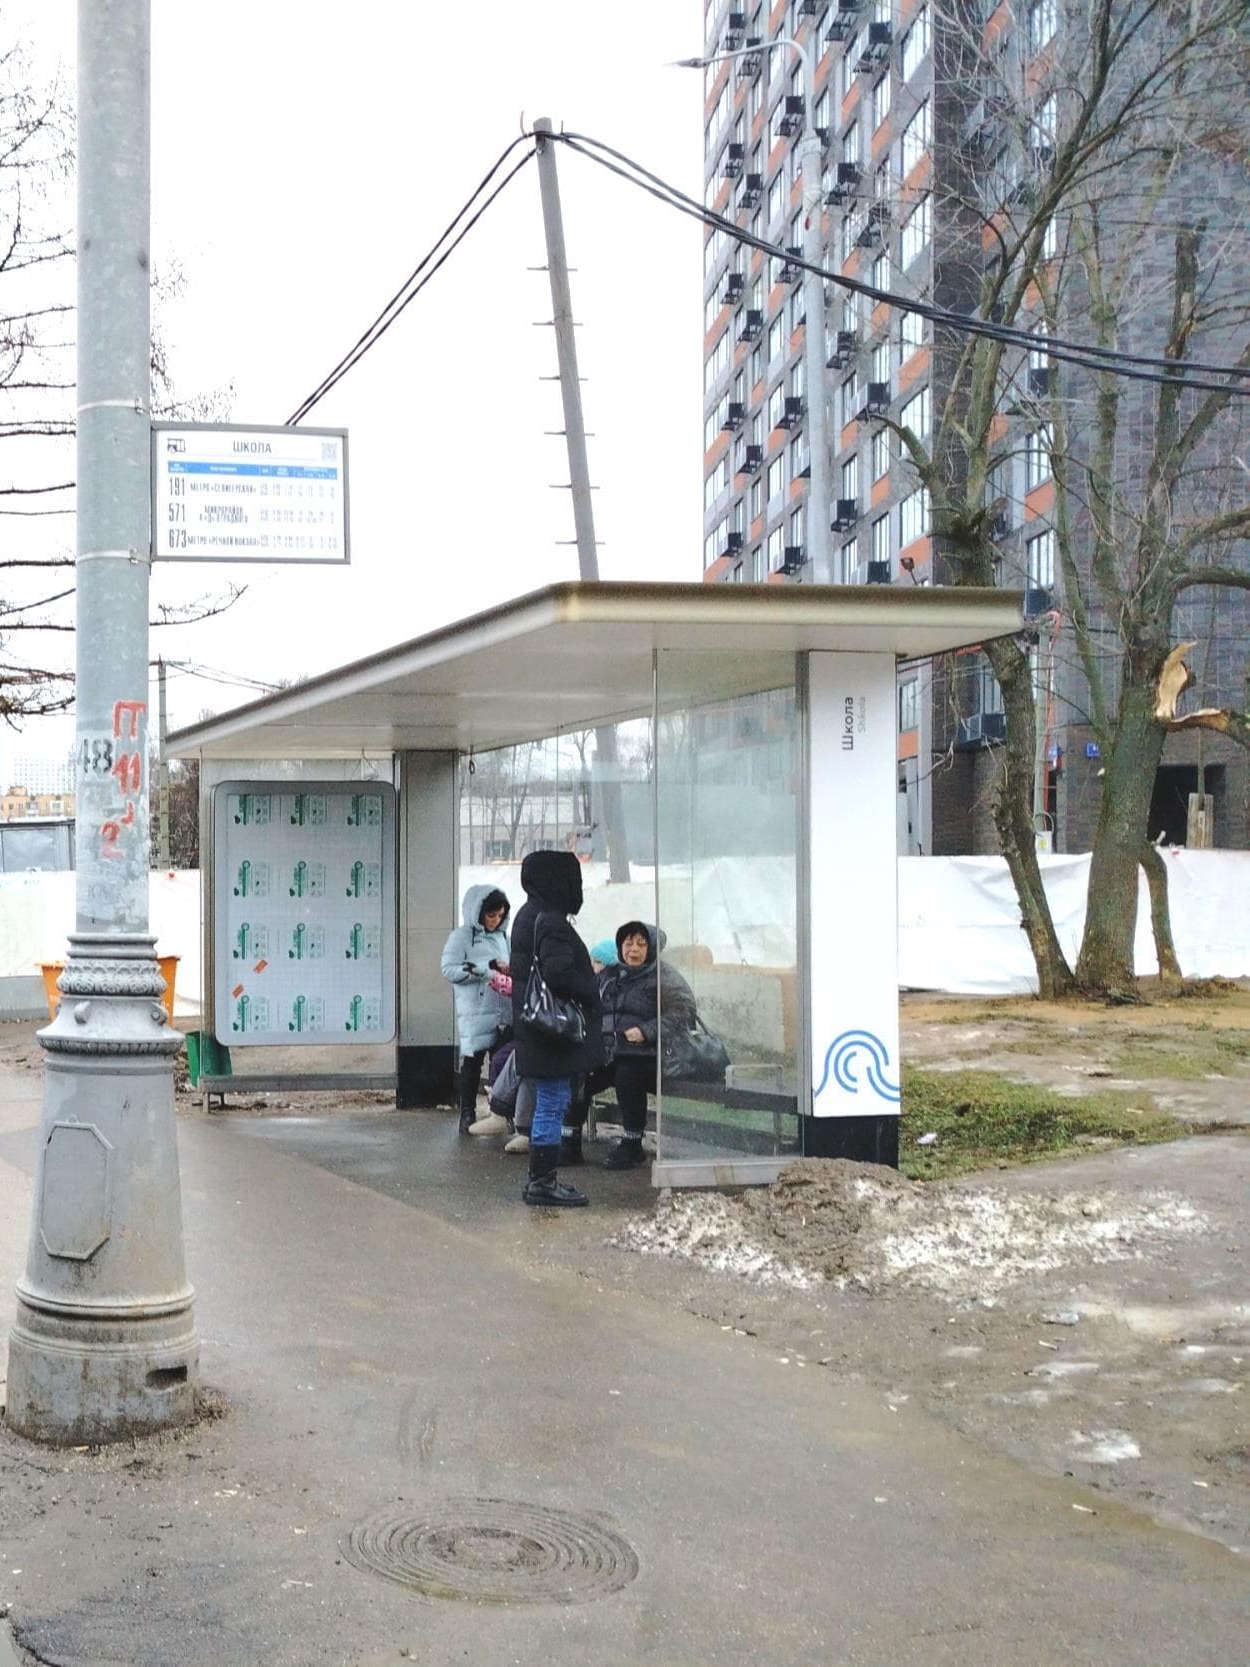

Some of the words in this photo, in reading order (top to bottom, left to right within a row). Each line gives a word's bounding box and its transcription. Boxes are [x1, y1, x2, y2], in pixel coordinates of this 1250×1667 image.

[232, 441, 272, 454] ШКОЛА
[169, 476, 185, 496] 191
[168, 502, 186, 522] 571
[168, 529, 187, 549] 673
[842, 696, 854, 751] Школа
